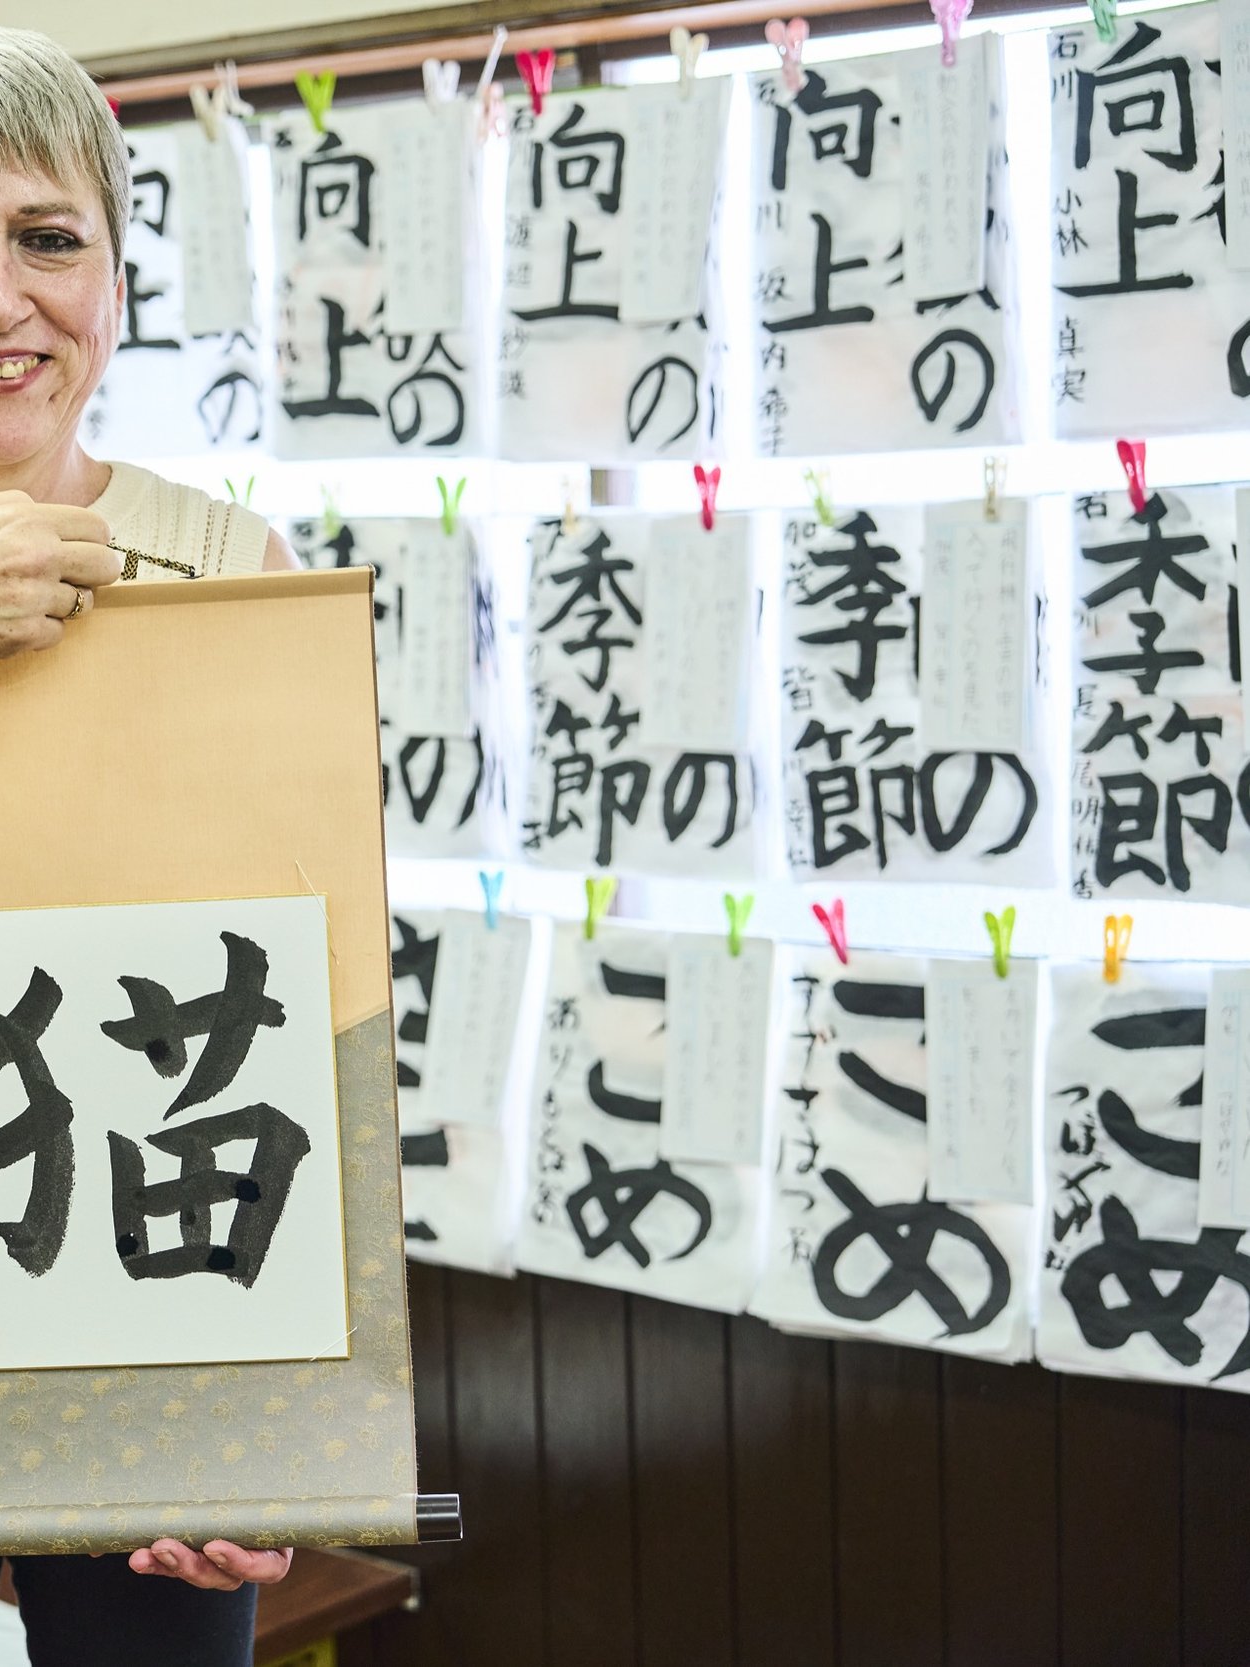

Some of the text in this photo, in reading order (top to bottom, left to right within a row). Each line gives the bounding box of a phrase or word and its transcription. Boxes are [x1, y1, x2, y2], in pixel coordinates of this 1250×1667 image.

[1051, 30, 1084, 101] 石川
[762, 69, 882, 333] 向上
[1054, 21, 1198, 298] 向上
[508, 104, 625, 325] 向上
[1055, 188, 1090, 258] 小林
[282, 132, 382, 418] 向上
[198, 370, 262, 443] の
[387, 372, 464, 446] の
[626, 355, 699, 450] の
[911, 328, 994, 432] の
[538, 530, 652, 868] 季節
[796, 510, 915, 870] 季節
[1080, 493, 1232, 892] 季節
[663, 752, 738, 850] の
[918, 752, 1038, 855] の
